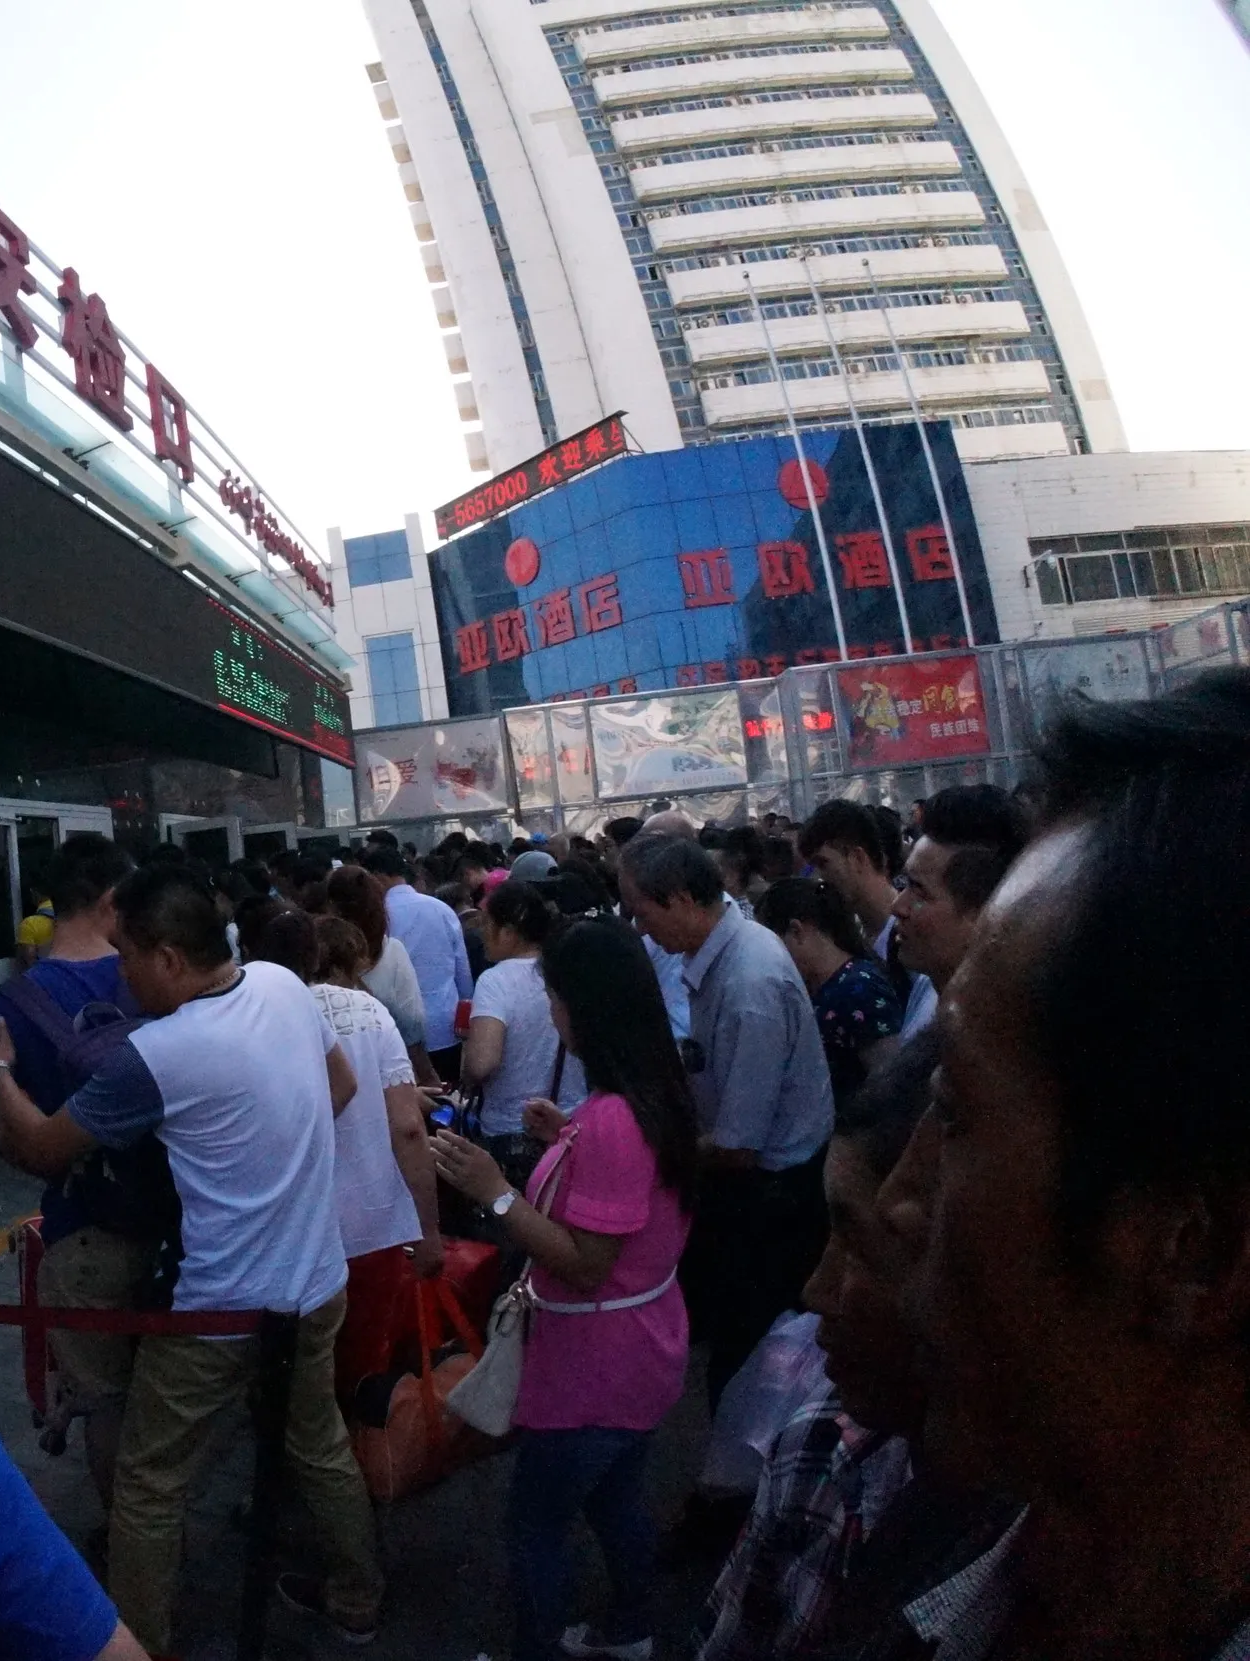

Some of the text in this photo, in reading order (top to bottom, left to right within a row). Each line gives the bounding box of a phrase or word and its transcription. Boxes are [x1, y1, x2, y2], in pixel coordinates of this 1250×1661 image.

[677, 524, 960, 608] 亚欧酒店
[456, 574, 624, 675] 亚欧酒店
